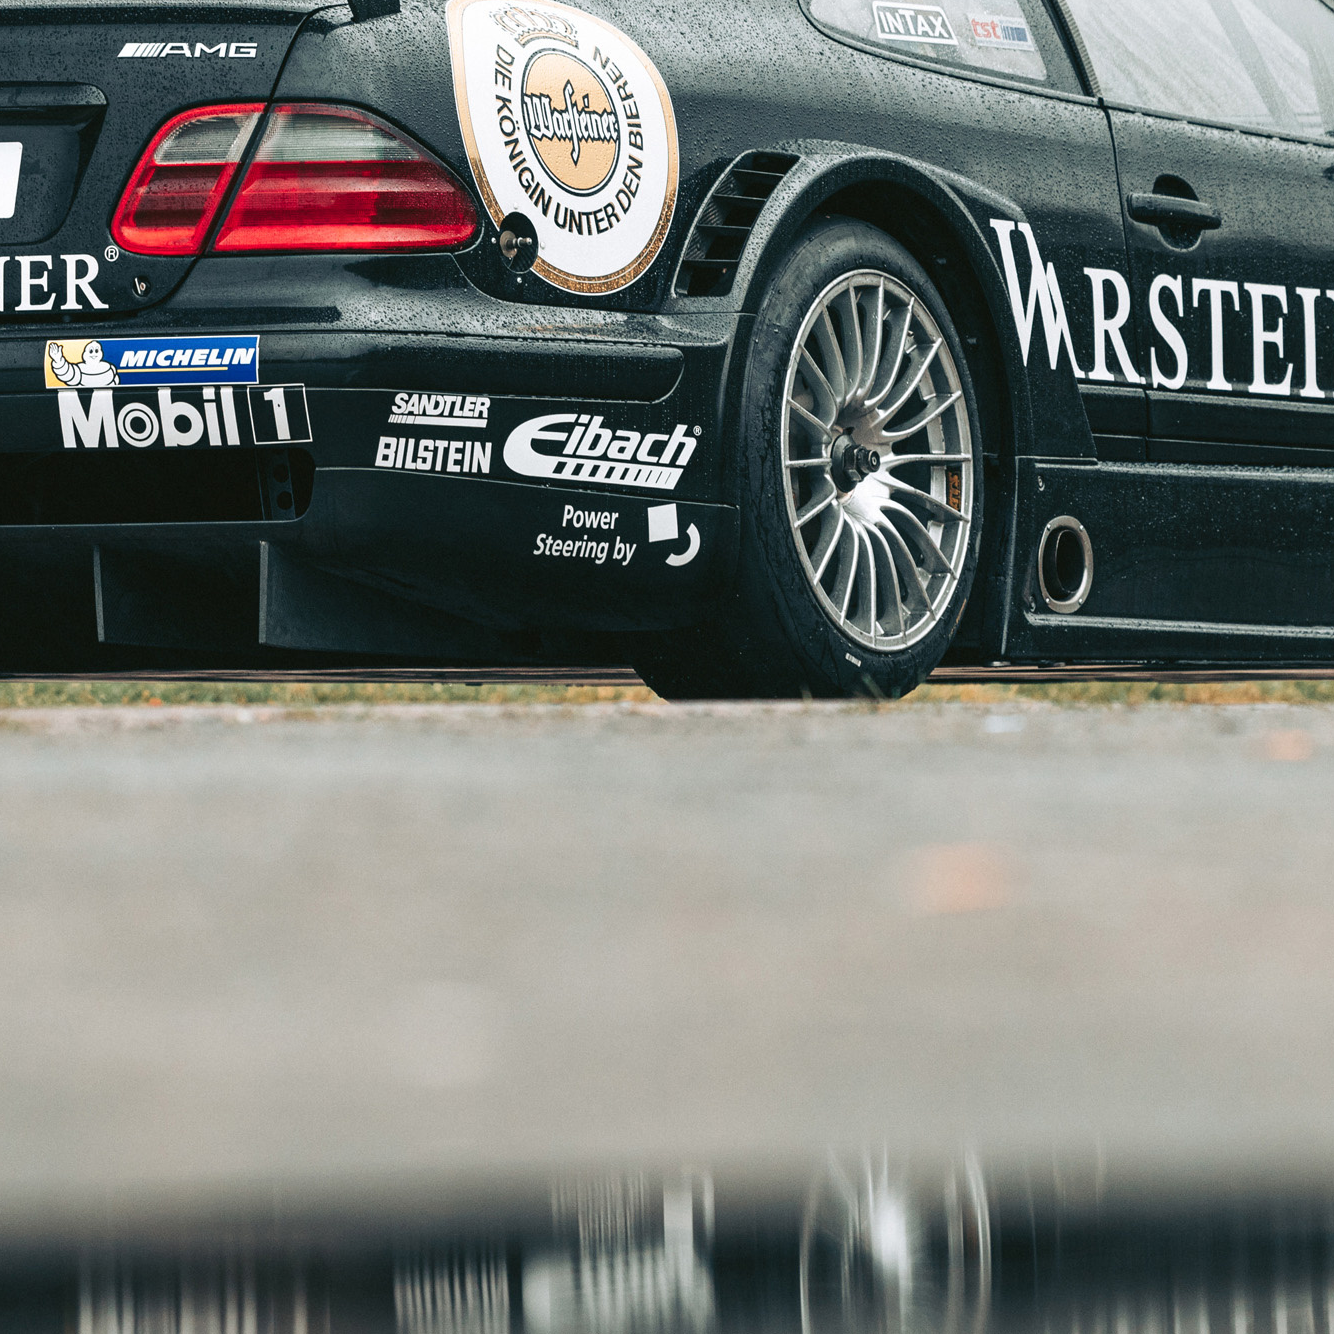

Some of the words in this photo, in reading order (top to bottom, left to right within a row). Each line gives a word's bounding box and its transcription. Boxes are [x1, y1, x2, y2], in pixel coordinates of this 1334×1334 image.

[879, 9, 949, 38] INTAX
[159, 42, 258, 58] AMG
[494, 44, 515, 93] DIE
[592, 46, 644, 151] BIEREN
[495, 94, 553, 218] KÖNIGIN
[616, 154, 644, 215] DEN
[553, 201, 620, 237] UNTER
[119, 347, 255, 368] MICHELIN
[57, 386, 241, 448] Mobil
[263, 388, 291, 440] 1
[391, 393, 490, 418] SANDTLER
[375, 436, 492, 474] BILSTEIN
[503, 413, 697, 489] Eibach
[562, 504, 618, 530] Power
[533, 533, 607, 564] Steering
[612, 536, 637, 565] by
